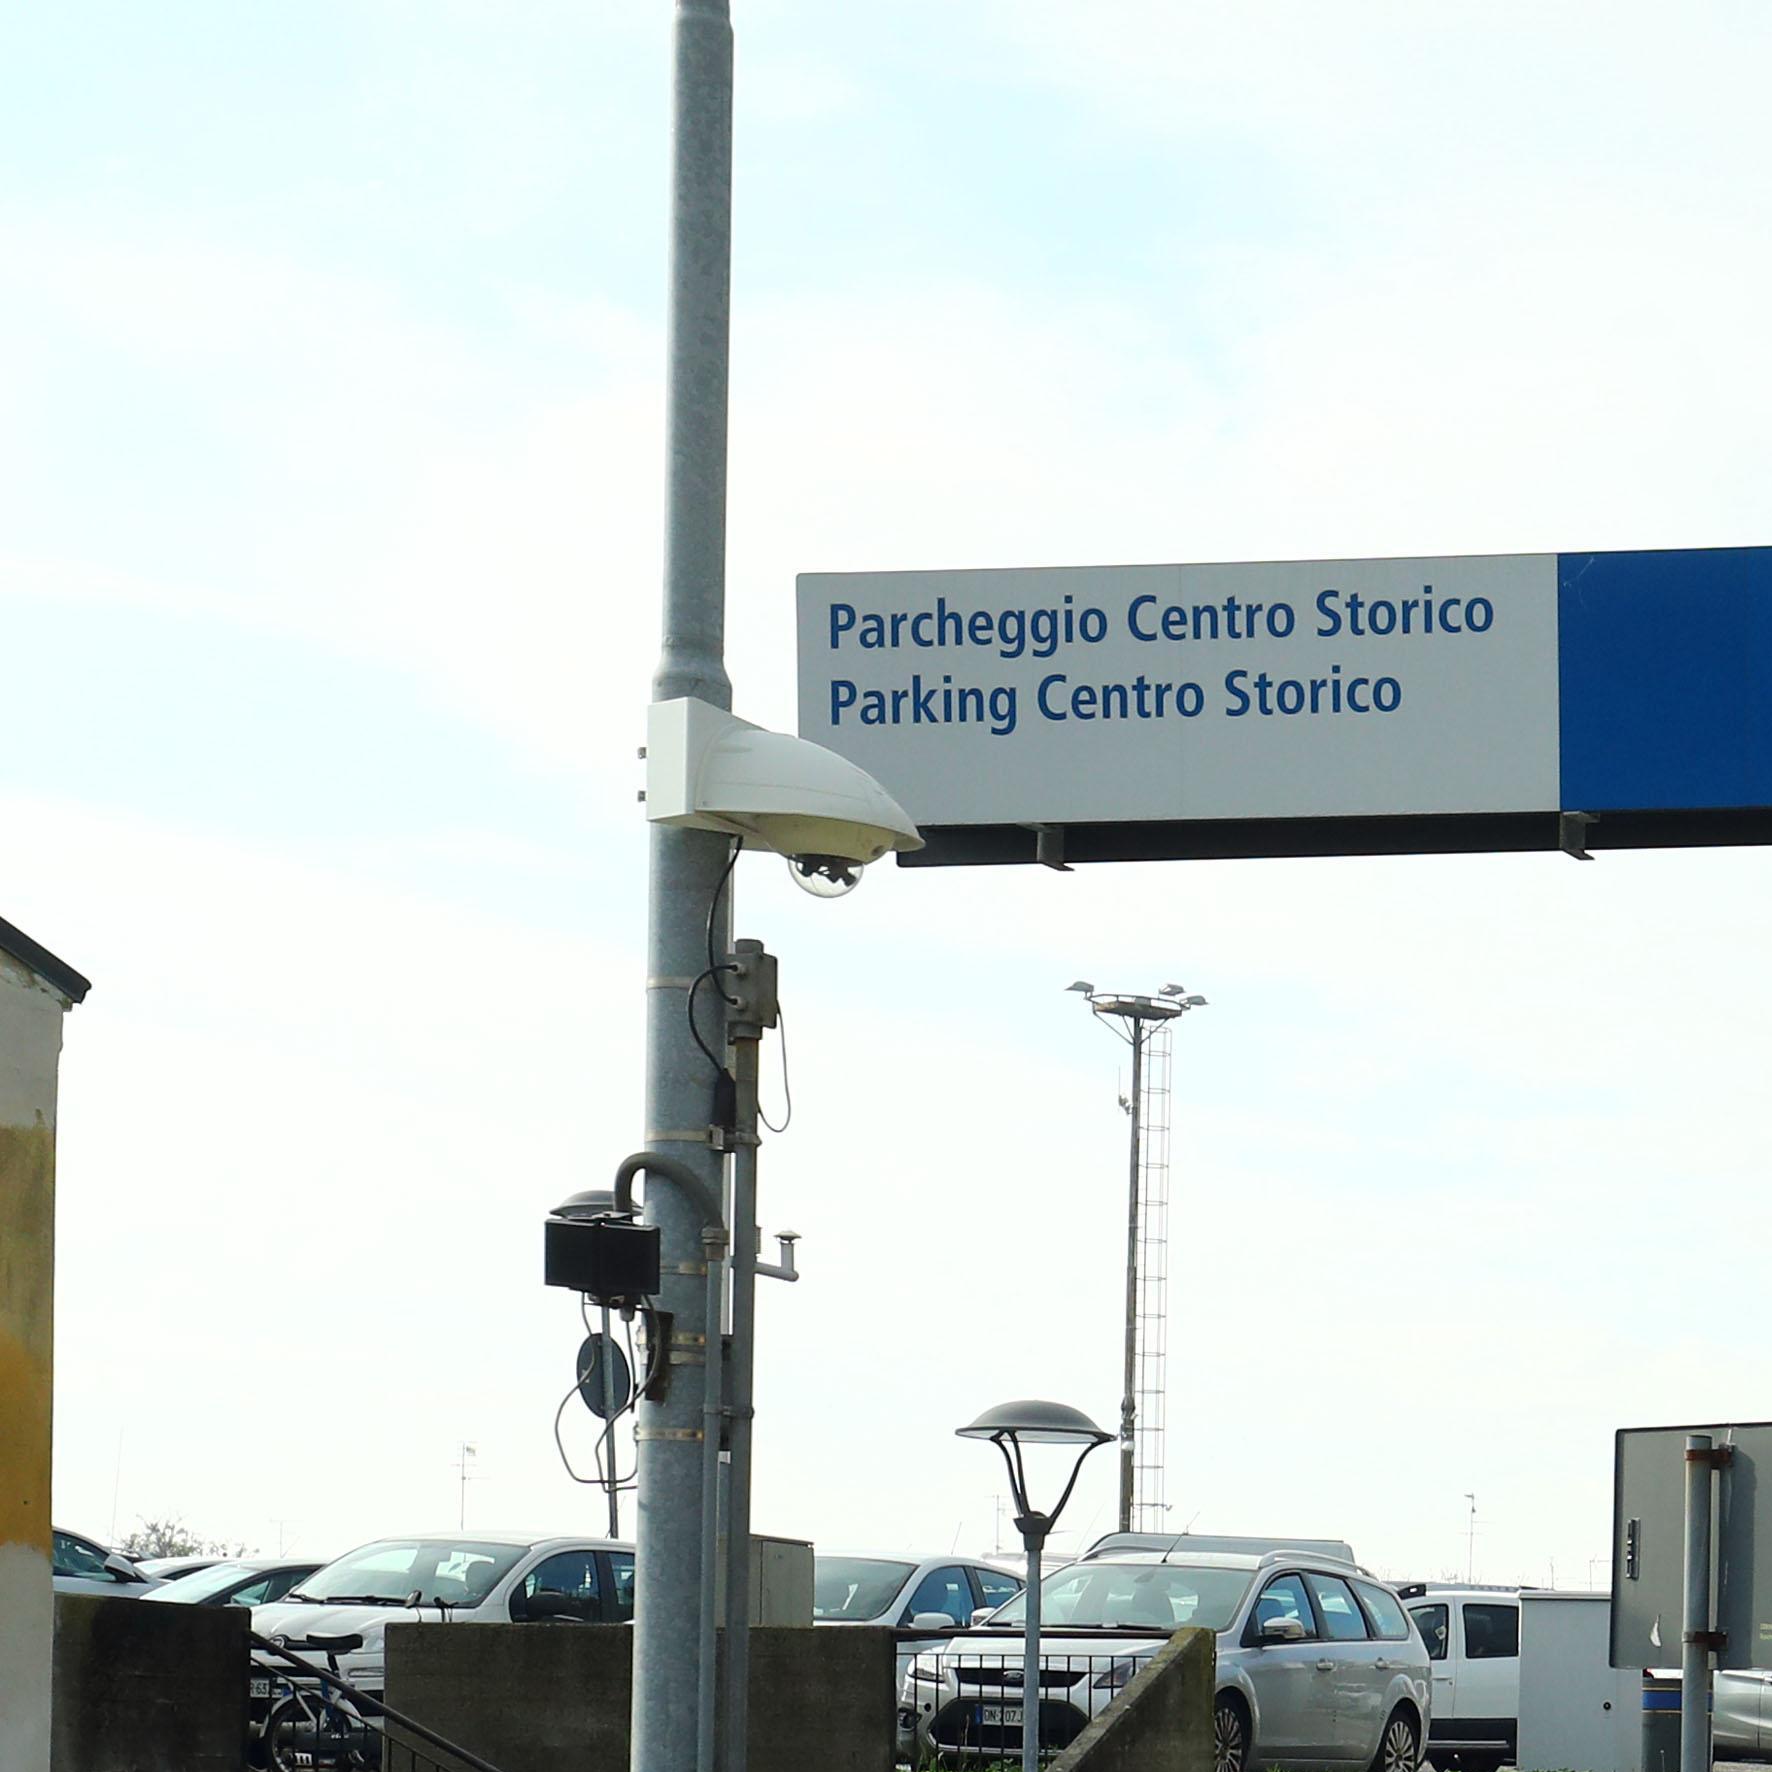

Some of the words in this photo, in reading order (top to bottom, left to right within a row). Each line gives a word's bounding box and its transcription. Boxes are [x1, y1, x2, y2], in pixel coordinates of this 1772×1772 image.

[829, 596, 1108, 659] Parcheggio
[1127, 593, 1295, 642] Centro
[1316, 586, 1494, 639] Storico
[830, 675, 1018, 736] Parking
[1037, 673, 1205, 722] Centro
[1225, 664, 1402, 718] Storico
